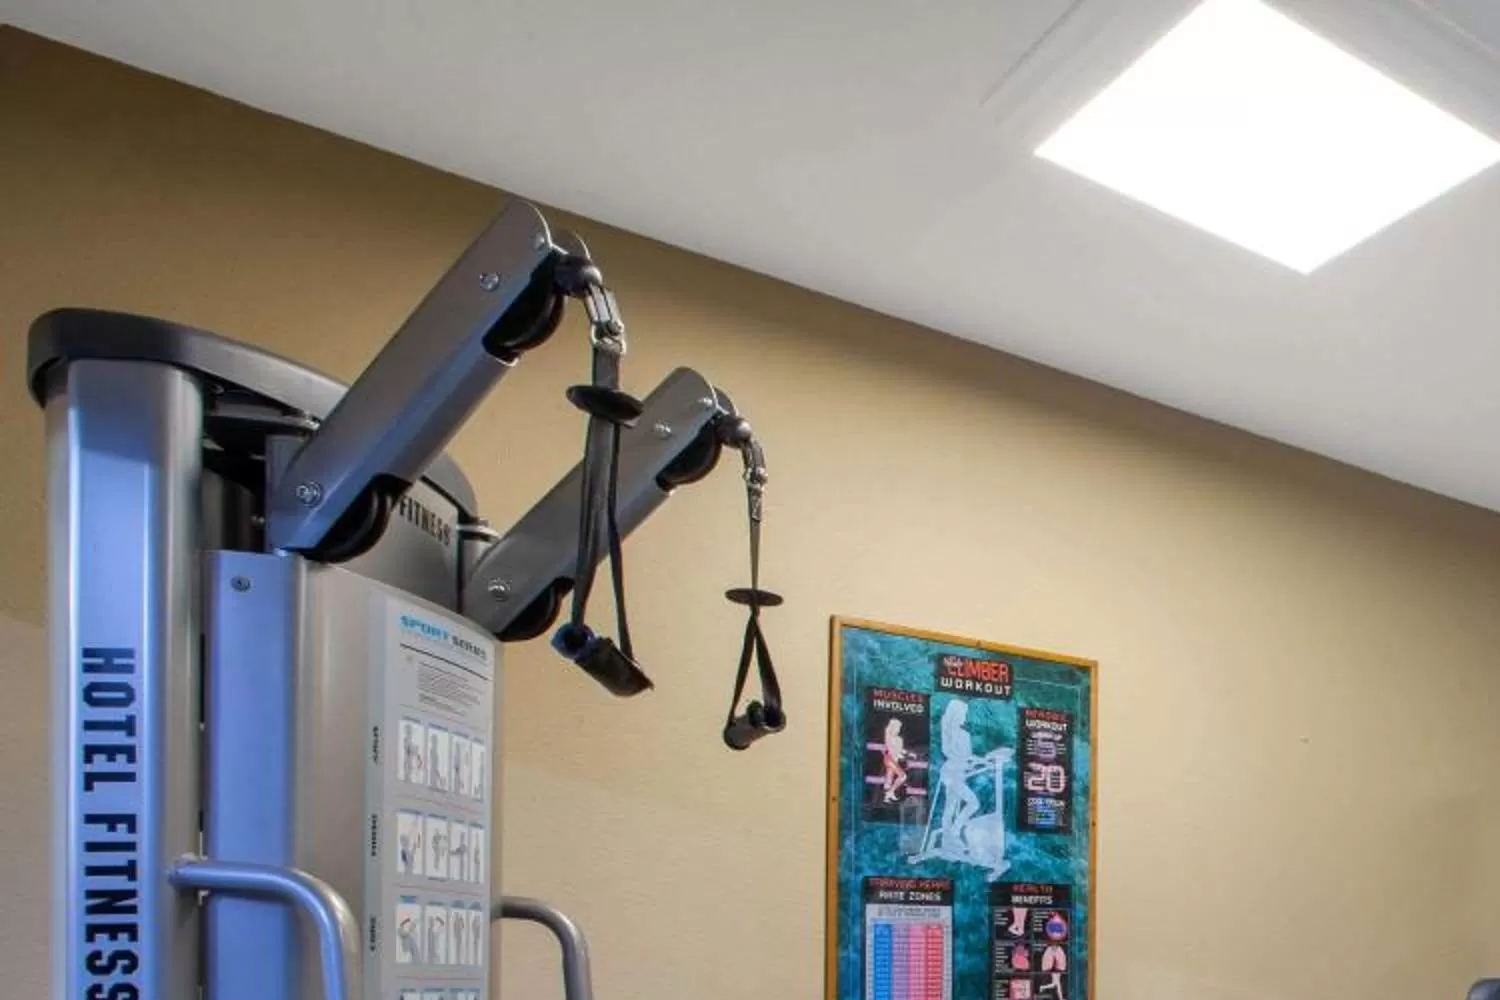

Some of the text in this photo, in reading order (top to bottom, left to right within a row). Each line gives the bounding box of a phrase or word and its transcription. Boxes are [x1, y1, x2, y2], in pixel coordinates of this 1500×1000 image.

[401, 614, 448, 640] SPORT
[947, 659, 1009, 683] CLIMBER
[941, 676, 1012, 696] WORKOUT
[873, 699, 925, 713] INVOLVED
[81, 647, 137, 792] HOTEL
